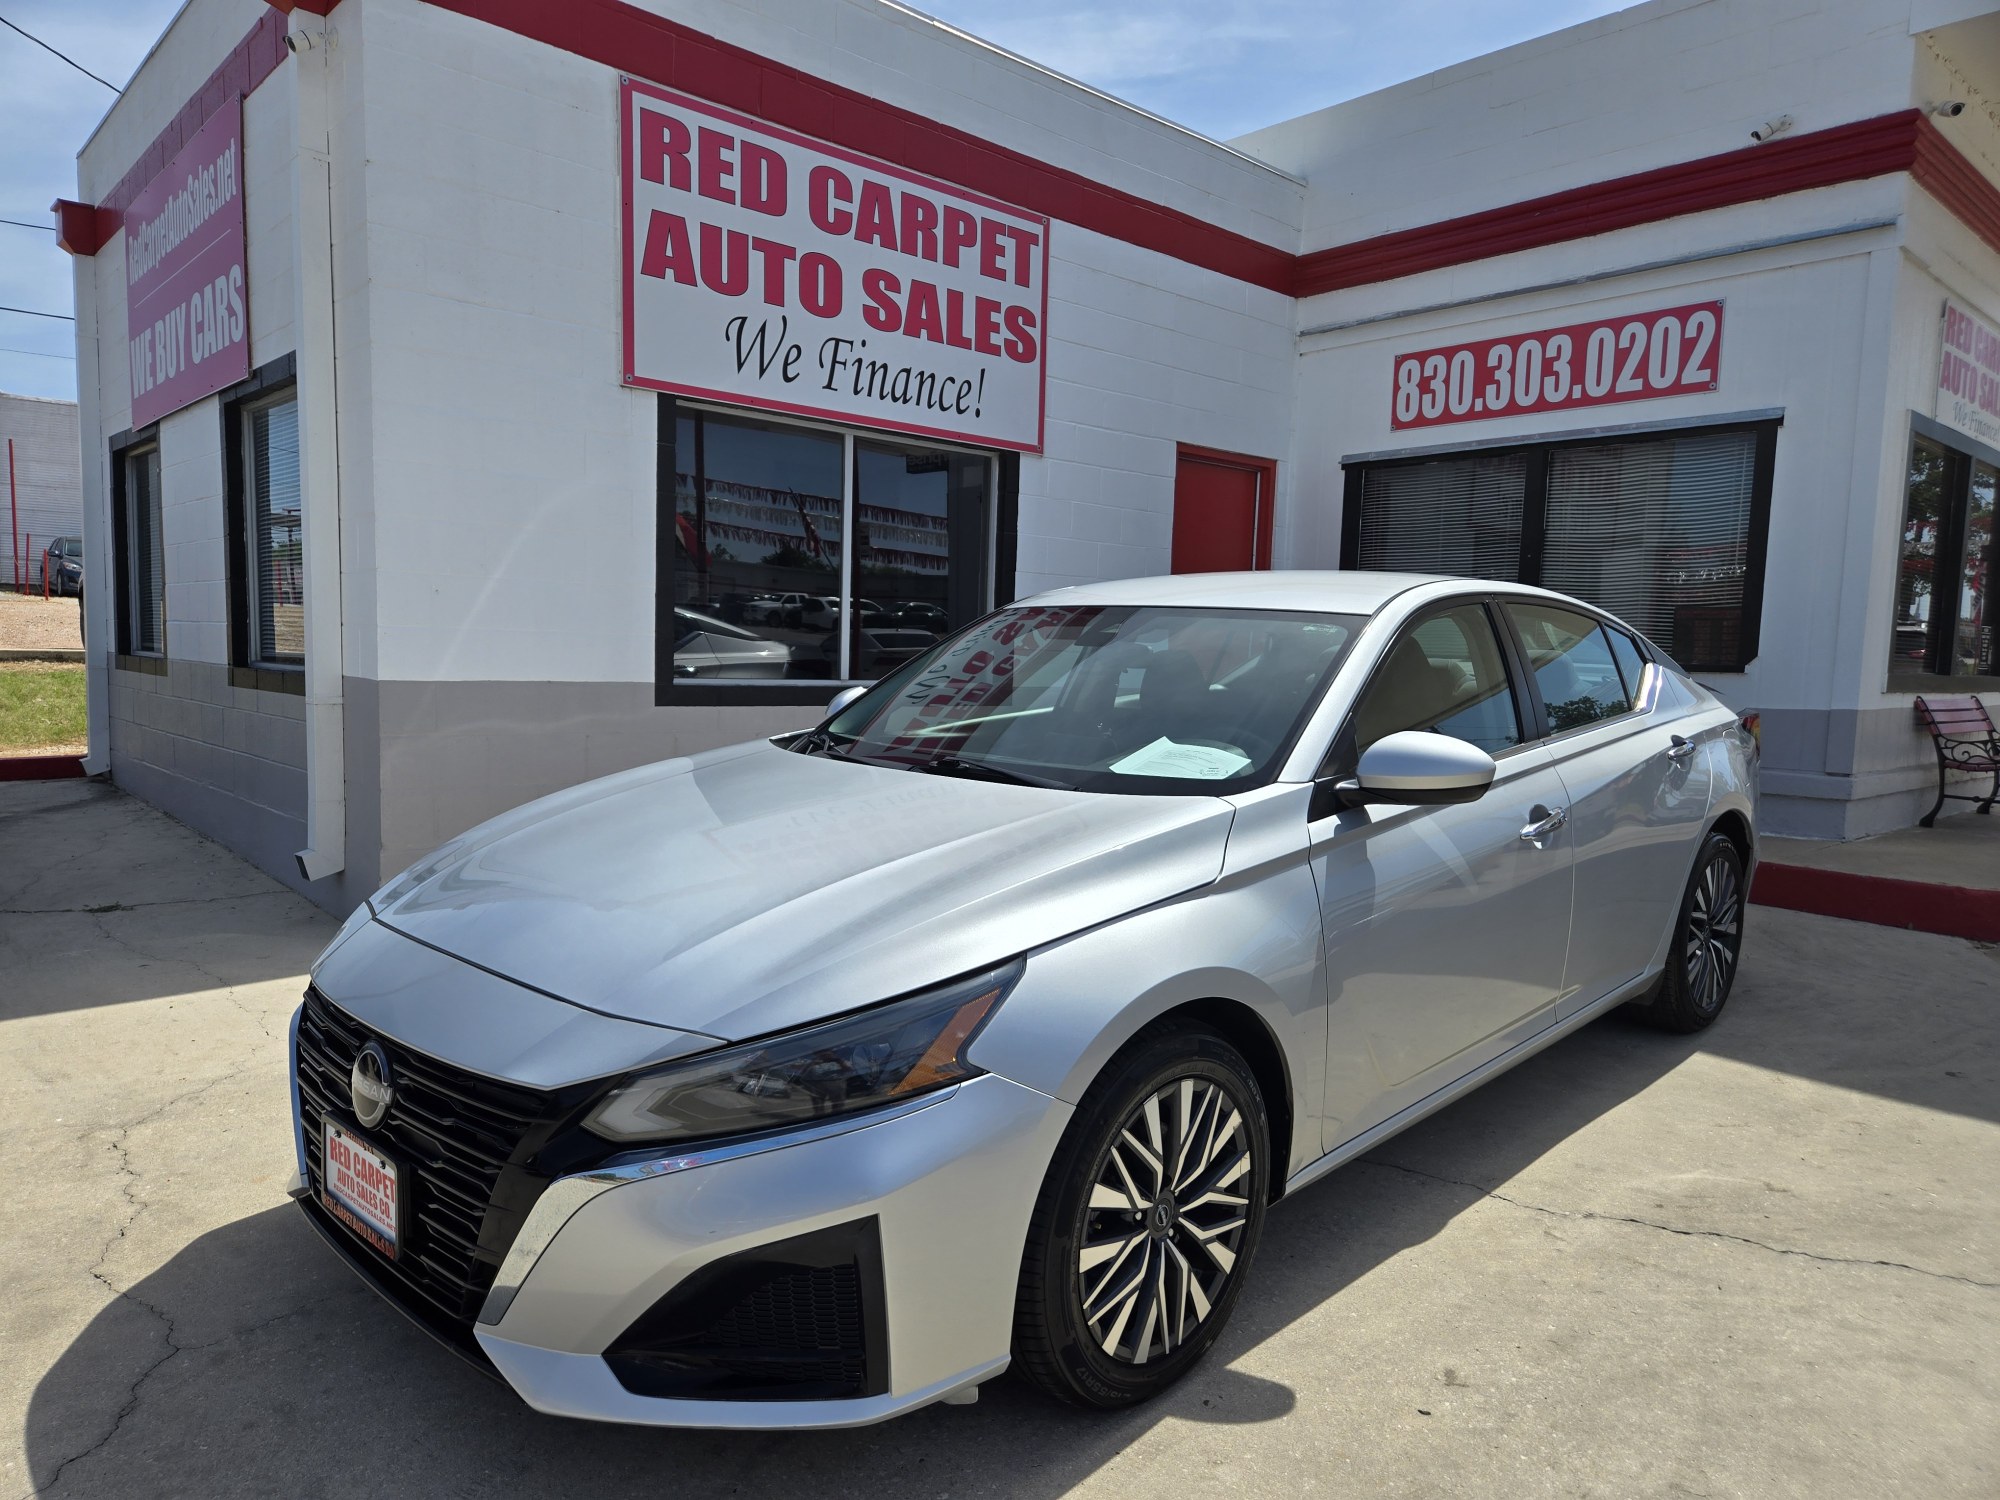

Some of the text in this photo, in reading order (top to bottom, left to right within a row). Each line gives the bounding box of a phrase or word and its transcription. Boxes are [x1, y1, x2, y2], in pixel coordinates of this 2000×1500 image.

[128, 137, 237, 286] RedCarpetAutoSales.net
[640, 107, 1039, 288] RED CARPET
[641, 209, 1037, 364] AUTO SALES
[131, 264, 244, 399] WE BUY CARS
[725, 315, 985, 418] We Finance!
[1396, 310, 1716, 423] 830.303.0202
[1944, 305, 1973, 355] RED
[1940, 350, 1978, 404] AUTO
[1953, 401, 1967, 427] We
[355, 1070, 391, 1102] SSAN
[330, 1135, 396, 1204] RED CARPET
[337, 1167, 393, 1222] AUTO SALES CO.
